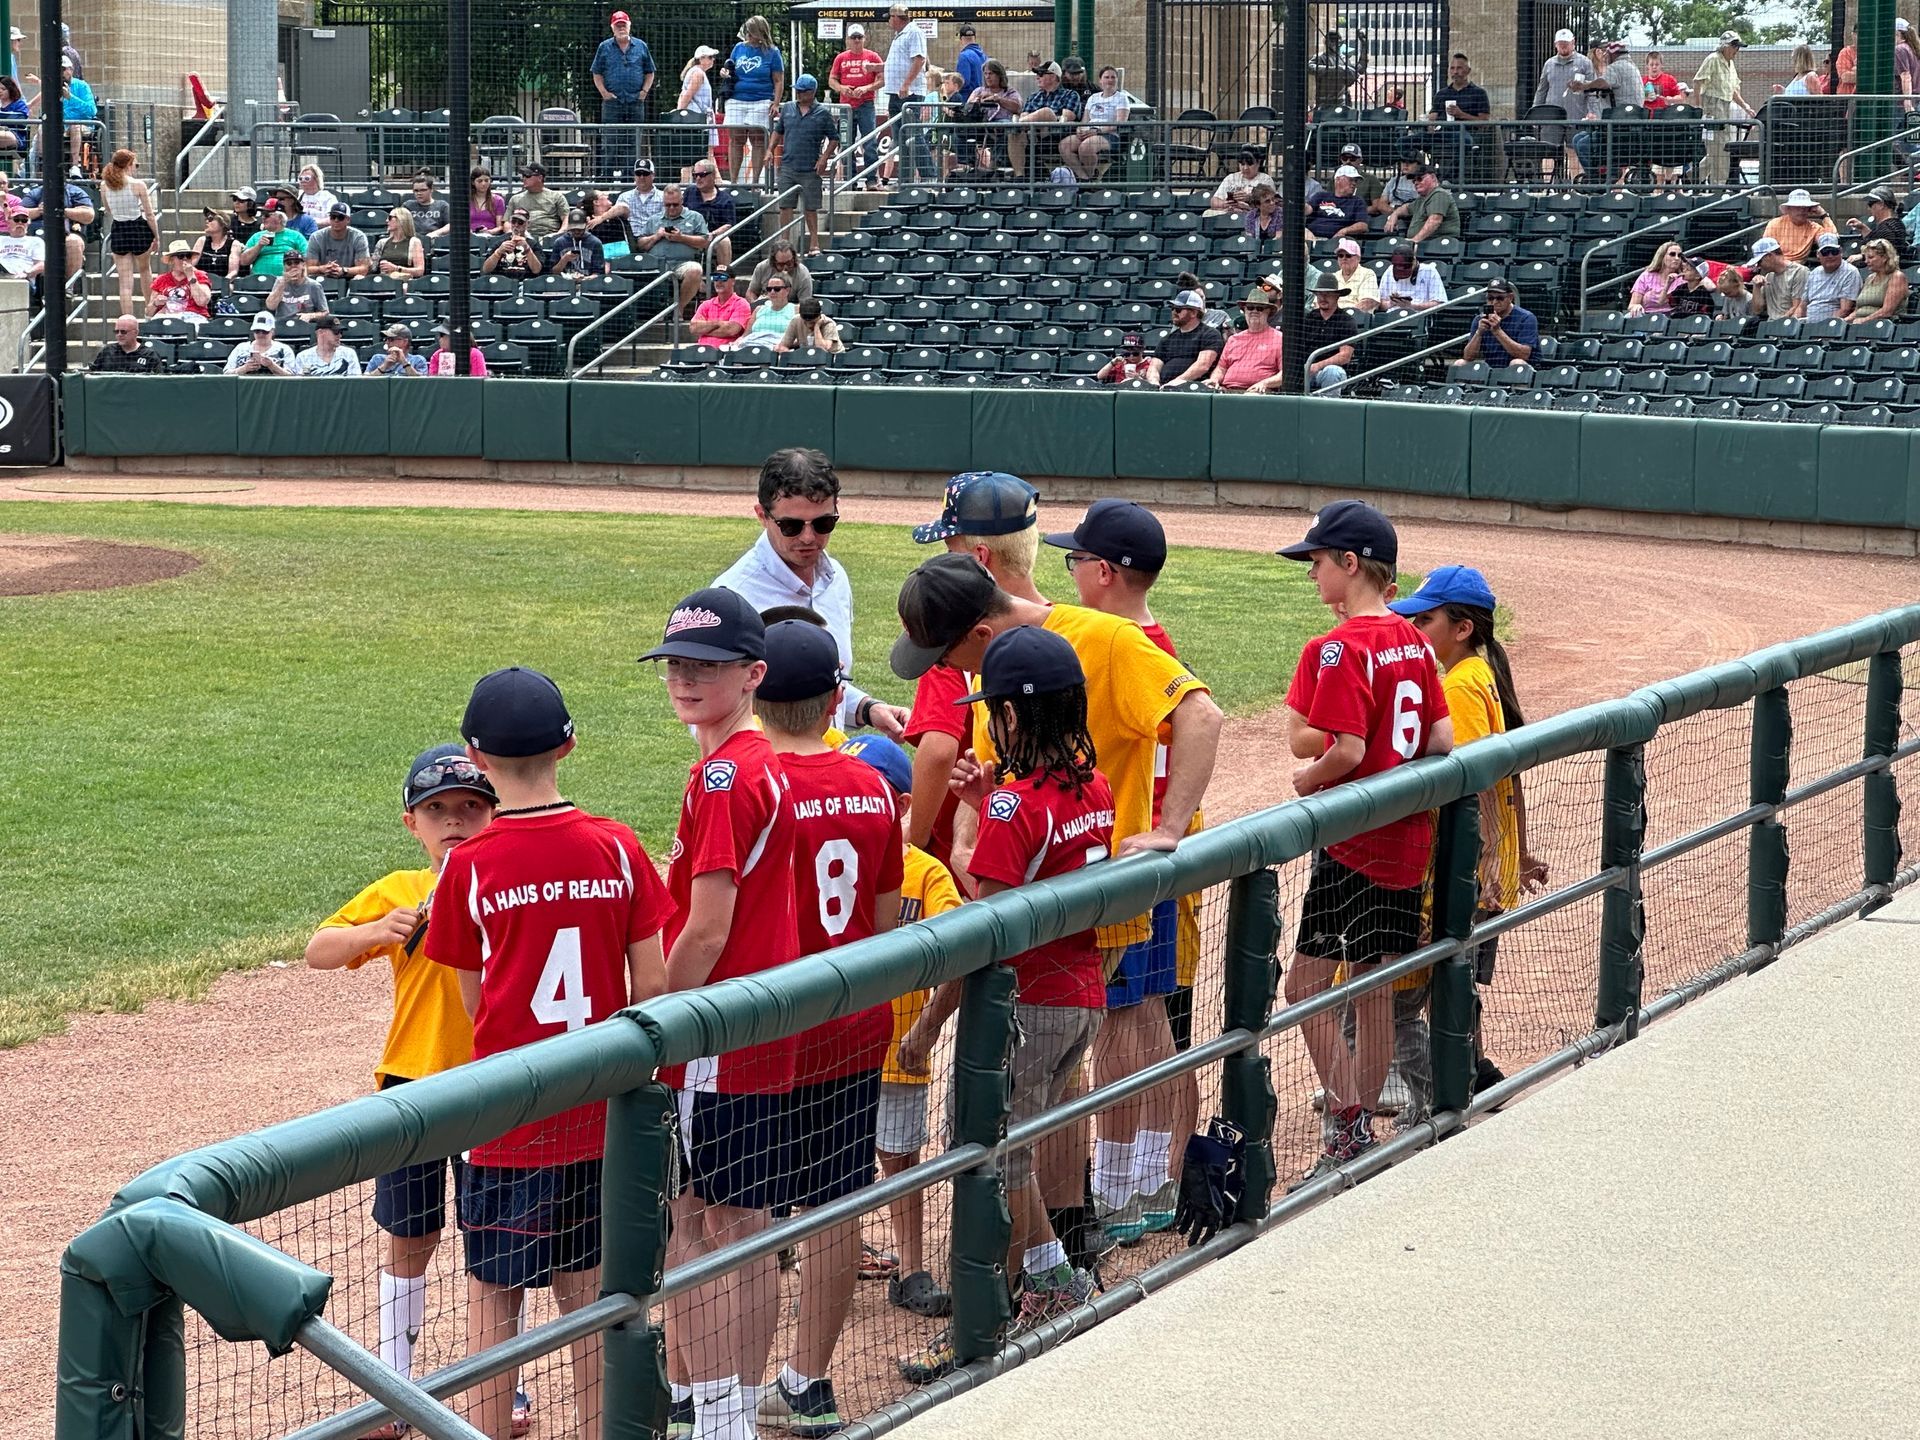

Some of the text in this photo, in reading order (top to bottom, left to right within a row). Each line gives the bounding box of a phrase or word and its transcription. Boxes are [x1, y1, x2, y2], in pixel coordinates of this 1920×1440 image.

[818, 10, 875, 18] CHEESE STEAK
[908, 10, 954, 18] EESE STEAK
[1008, 9, 1033, 17] STEAK
[1392, 680, 1423, 759] 6
[825, 797, 842, 816] OF
[845, 796, 886, 815] REALTY
[1052, 829, 1063, 846] A
[482, 878, 625, 917] A HAUS OF REALTY
[815, 839, 859, 937] 8
[530, 926, 592, 1032] 4
